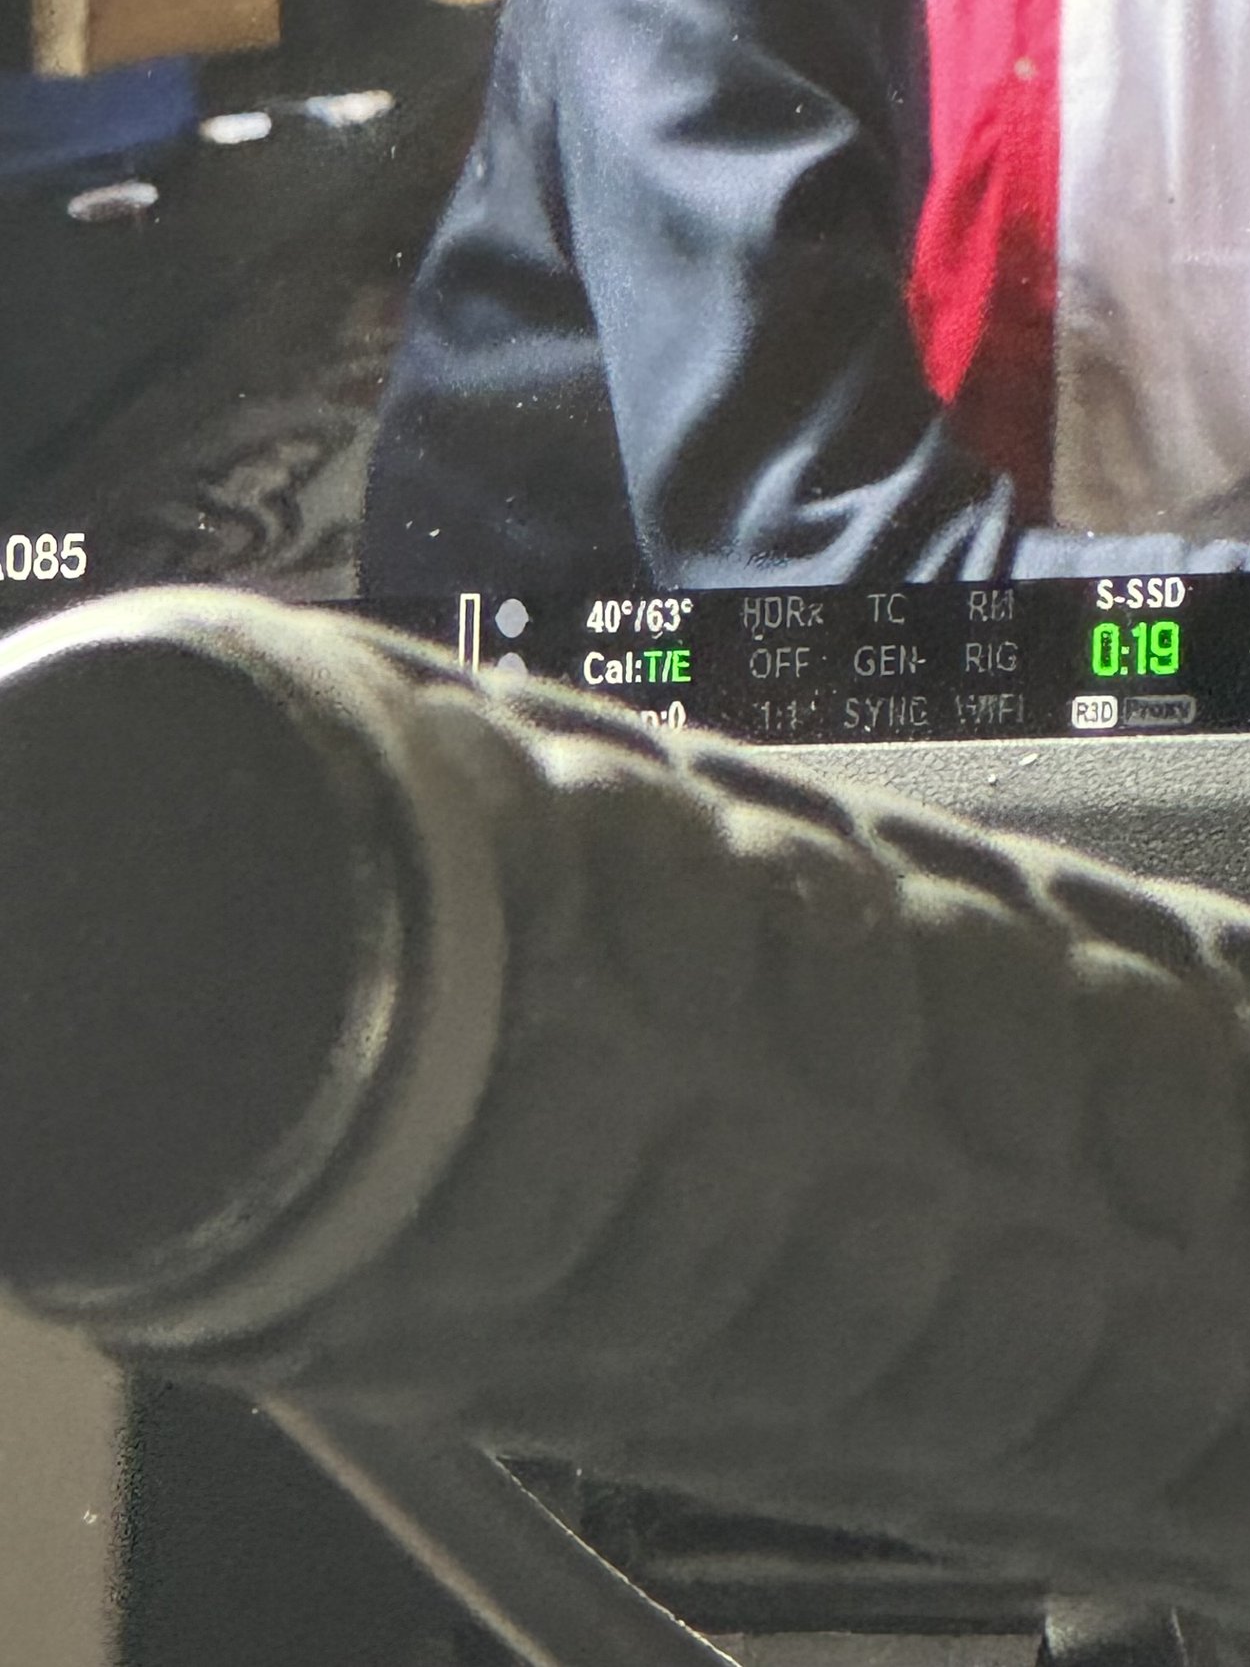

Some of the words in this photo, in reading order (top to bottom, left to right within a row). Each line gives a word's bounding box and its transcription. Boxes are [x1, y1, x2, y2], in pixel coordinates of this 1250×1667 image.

[0, 533, 87, 581] 085
[867, 592, 906, 624] TC
[1096, 577, 1185, 609] S-SSD
[750, 647, 811, 679] OFF
[965, 641, 1019, 674] RIG
[1092, 622, 1180, 675] 0:19
[584, 650, 692, 684] Cal:T/E
[1077, 701, 1113, 723] R3D
